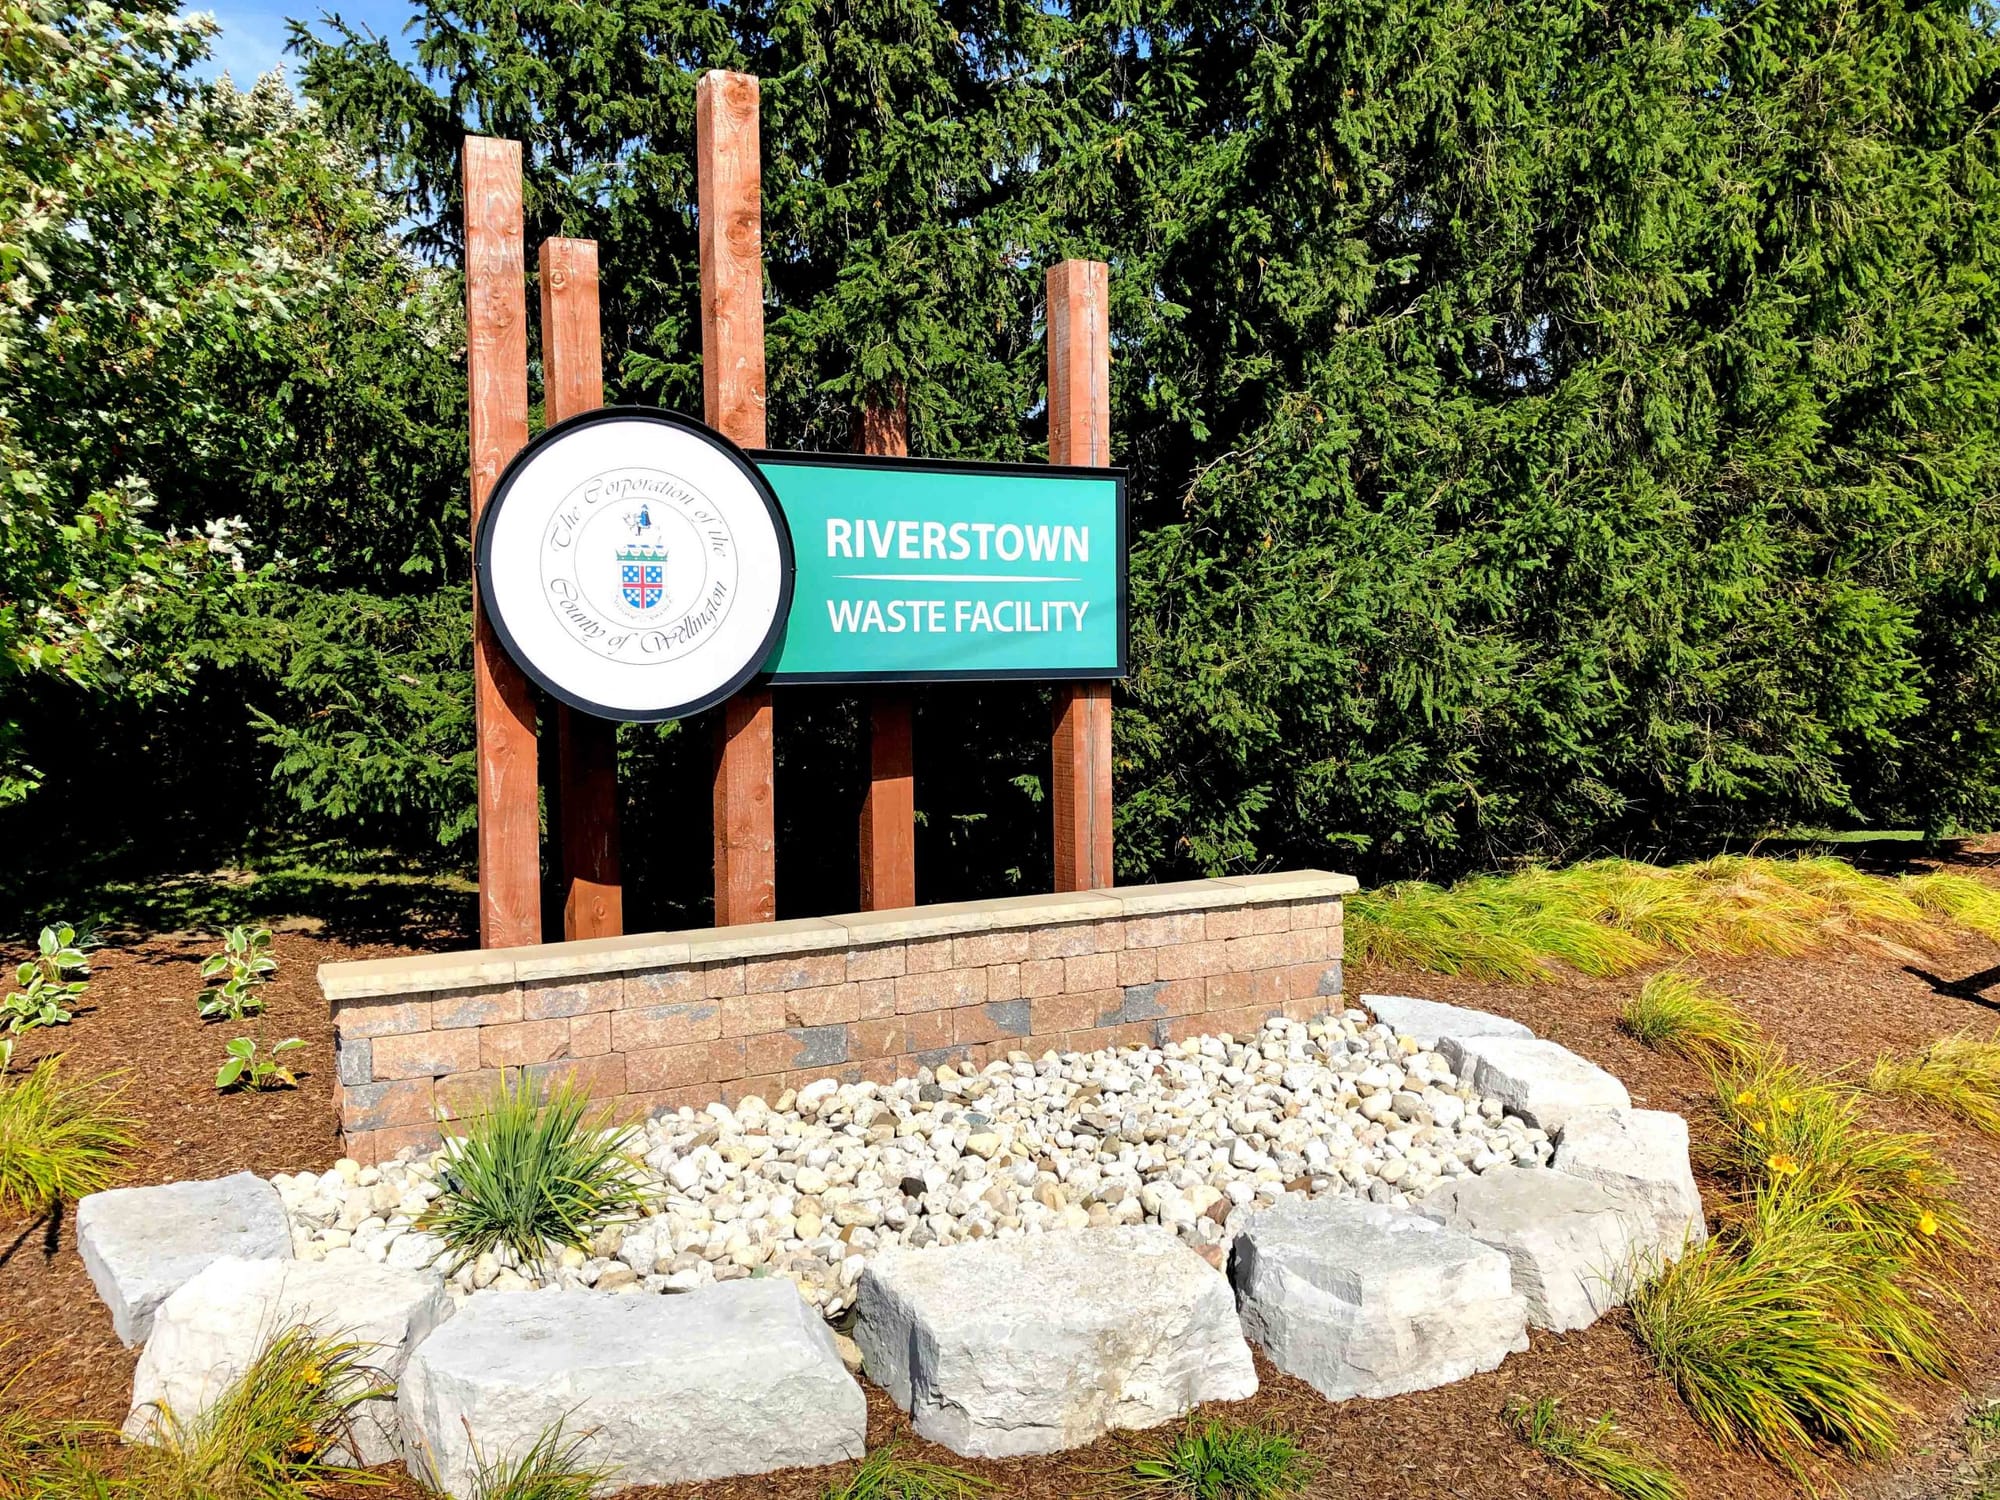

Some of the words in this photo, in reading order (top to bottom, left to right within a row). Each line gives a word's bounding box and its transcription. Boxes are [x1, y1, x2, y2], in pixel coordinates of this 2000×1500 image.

[550, 506, 581, 552] The
[584, 478, 695, 505] Corporation
[691, 510, 722, 526] of
[708, 529, 729, 558] the
[826, 518, 1089, 562] RIVERSTOWN
[550, 578, 606, 642] County
[608, 632, 639, 655] of
[641, 581, 728, 653] Wellington
[826, 600, 947, 633] WASTE
[954, 600, 1090, 633] FACILITY
